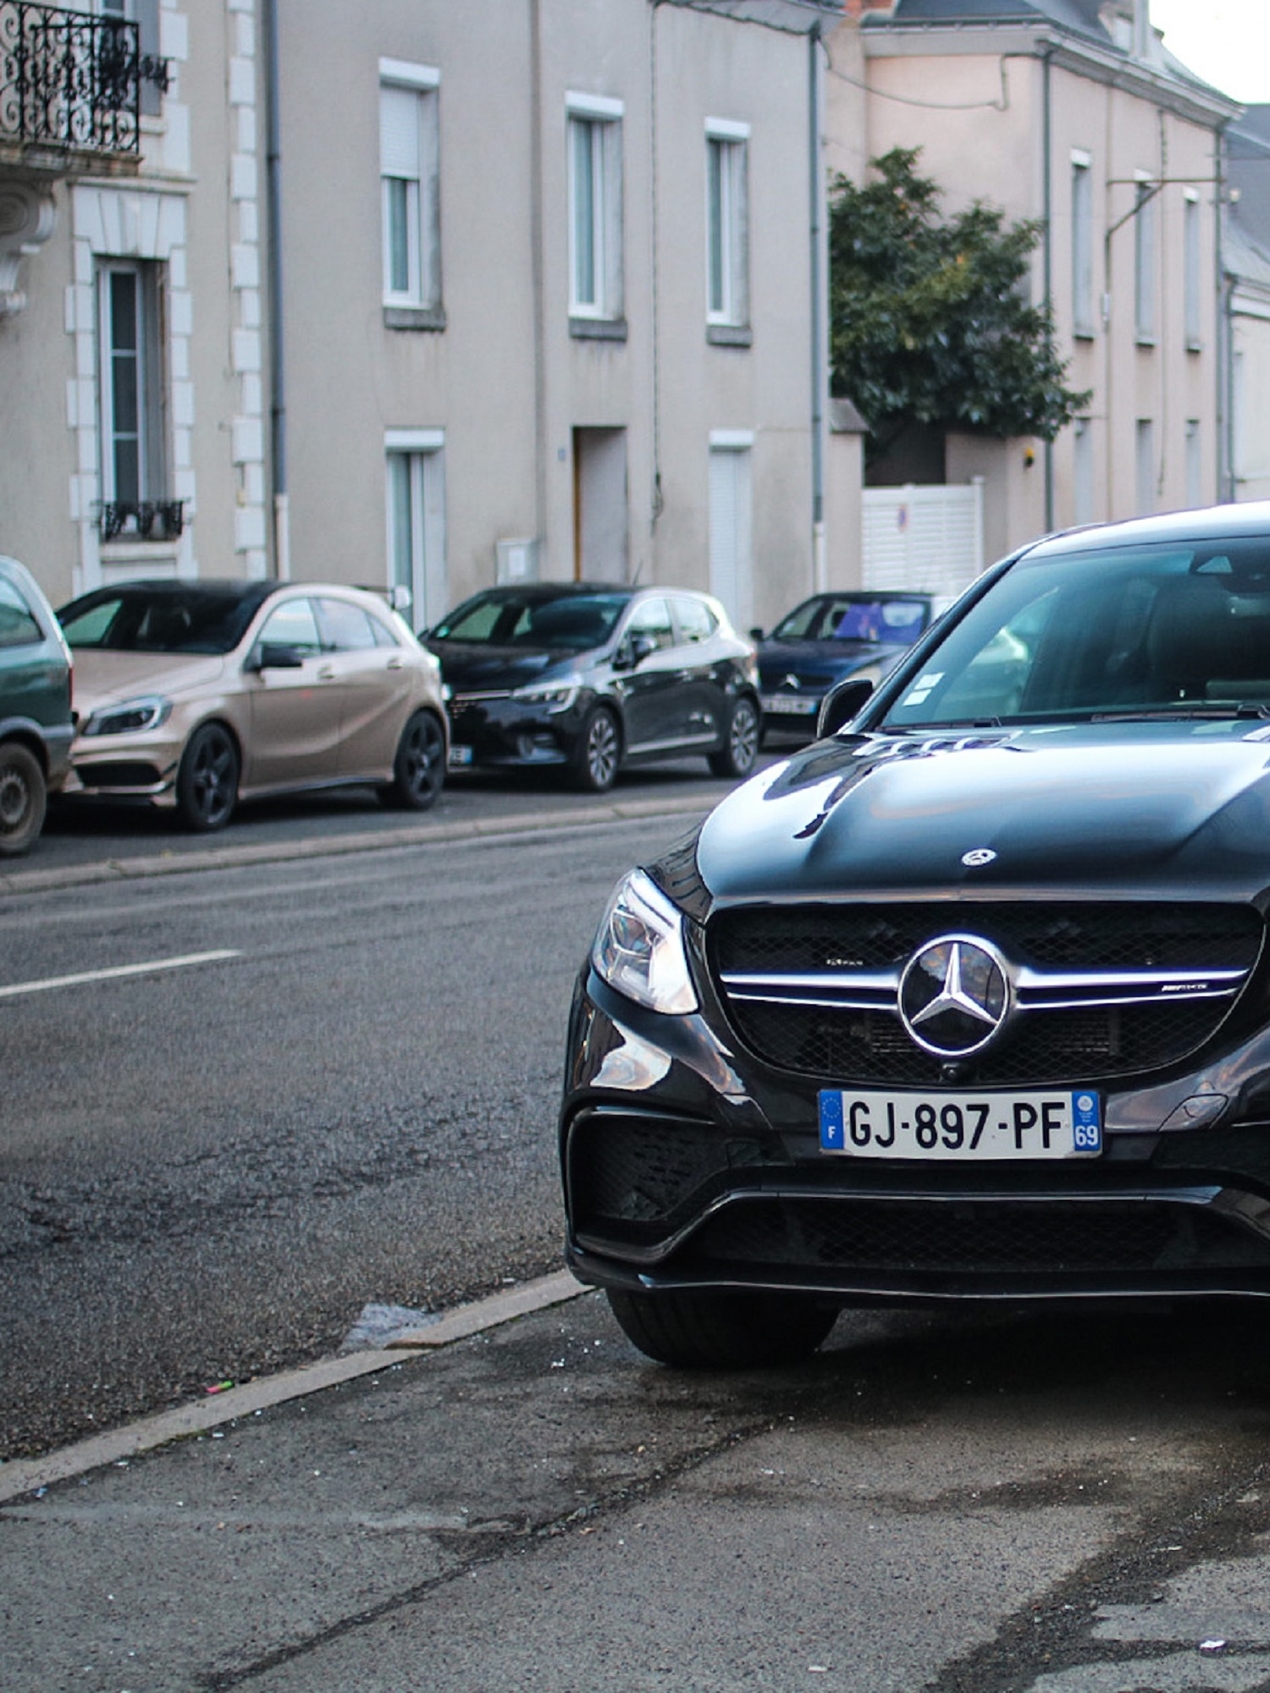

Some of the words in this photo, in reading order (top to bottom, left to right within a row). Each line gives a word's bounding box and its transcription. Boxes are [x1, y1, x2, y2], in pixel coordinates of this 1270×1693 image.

[827, 1125, 837, 1140] F
[848, 1101, 1066, 1150] GJ-897-PF
[1075, 1124, 1099, 1147] 69
